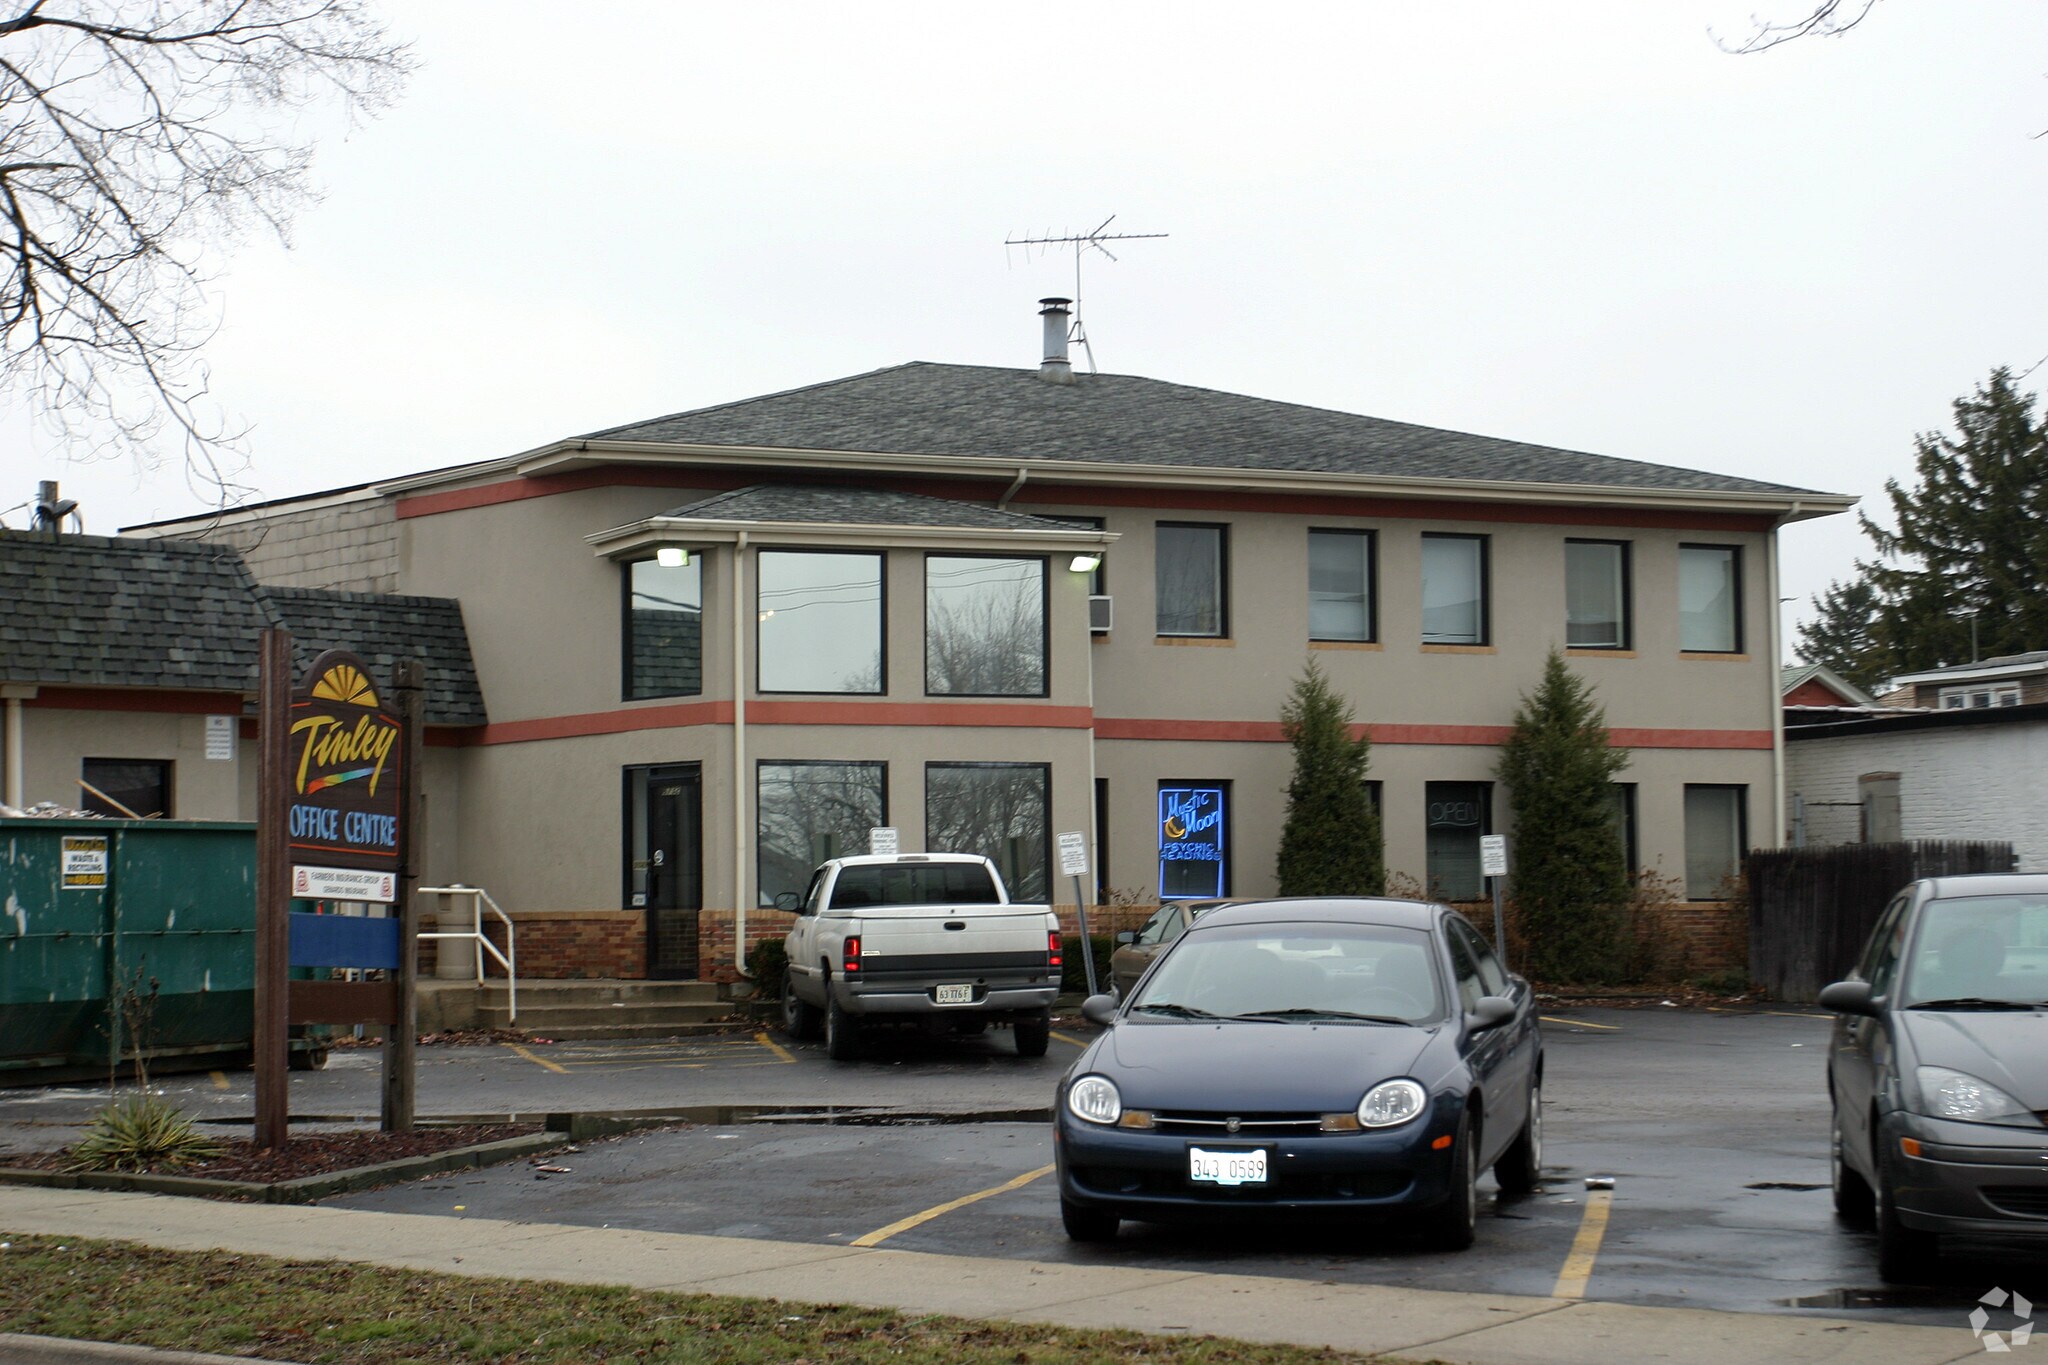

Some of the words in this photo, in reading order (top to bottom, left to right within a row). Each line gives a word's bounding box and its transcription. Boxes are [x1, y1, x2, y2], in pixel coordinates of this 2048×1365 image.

[290, 714, 397, 798] Tinley
[1163, 792, 1210, 822] Mystic
[1430, 802, 1479, 821] OPEN
[289, 804, 339, 840] OFFICE
[344, 811, 397, 846] CENTRE
[1181, 810, 1221, 839] Moon
[1160, 851, 1221, 861] READINGS
[1164, 842, 1215, 852] PSYCHIC
[1193, 1159, 1220, 1178] 343
[1229, 1160, 1264, 1179] 0589
